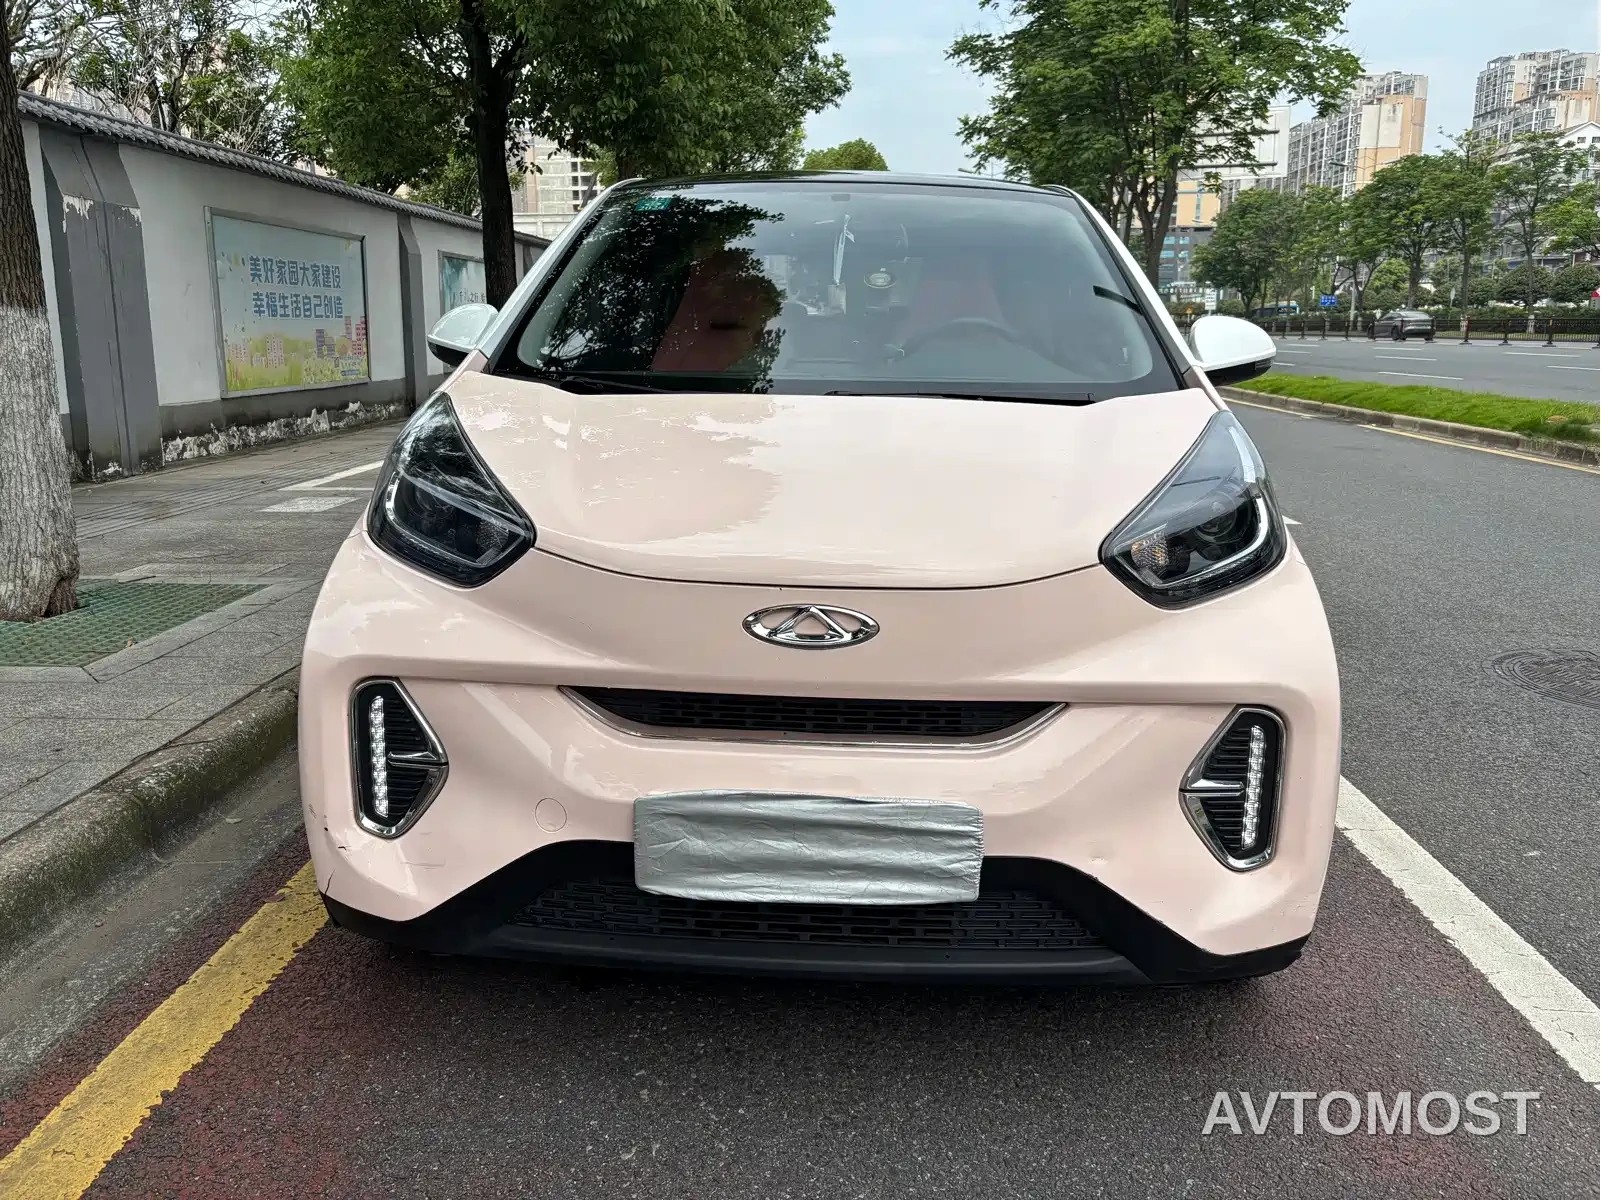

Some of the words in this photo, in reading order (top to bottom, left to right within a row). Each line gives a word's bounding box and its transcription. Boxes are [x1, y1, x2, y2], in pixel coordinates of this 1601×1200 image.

[249, 255, 341, 288] 美好家园大家建设
[252, 291, 343, 319] 幸福生活自己创造
